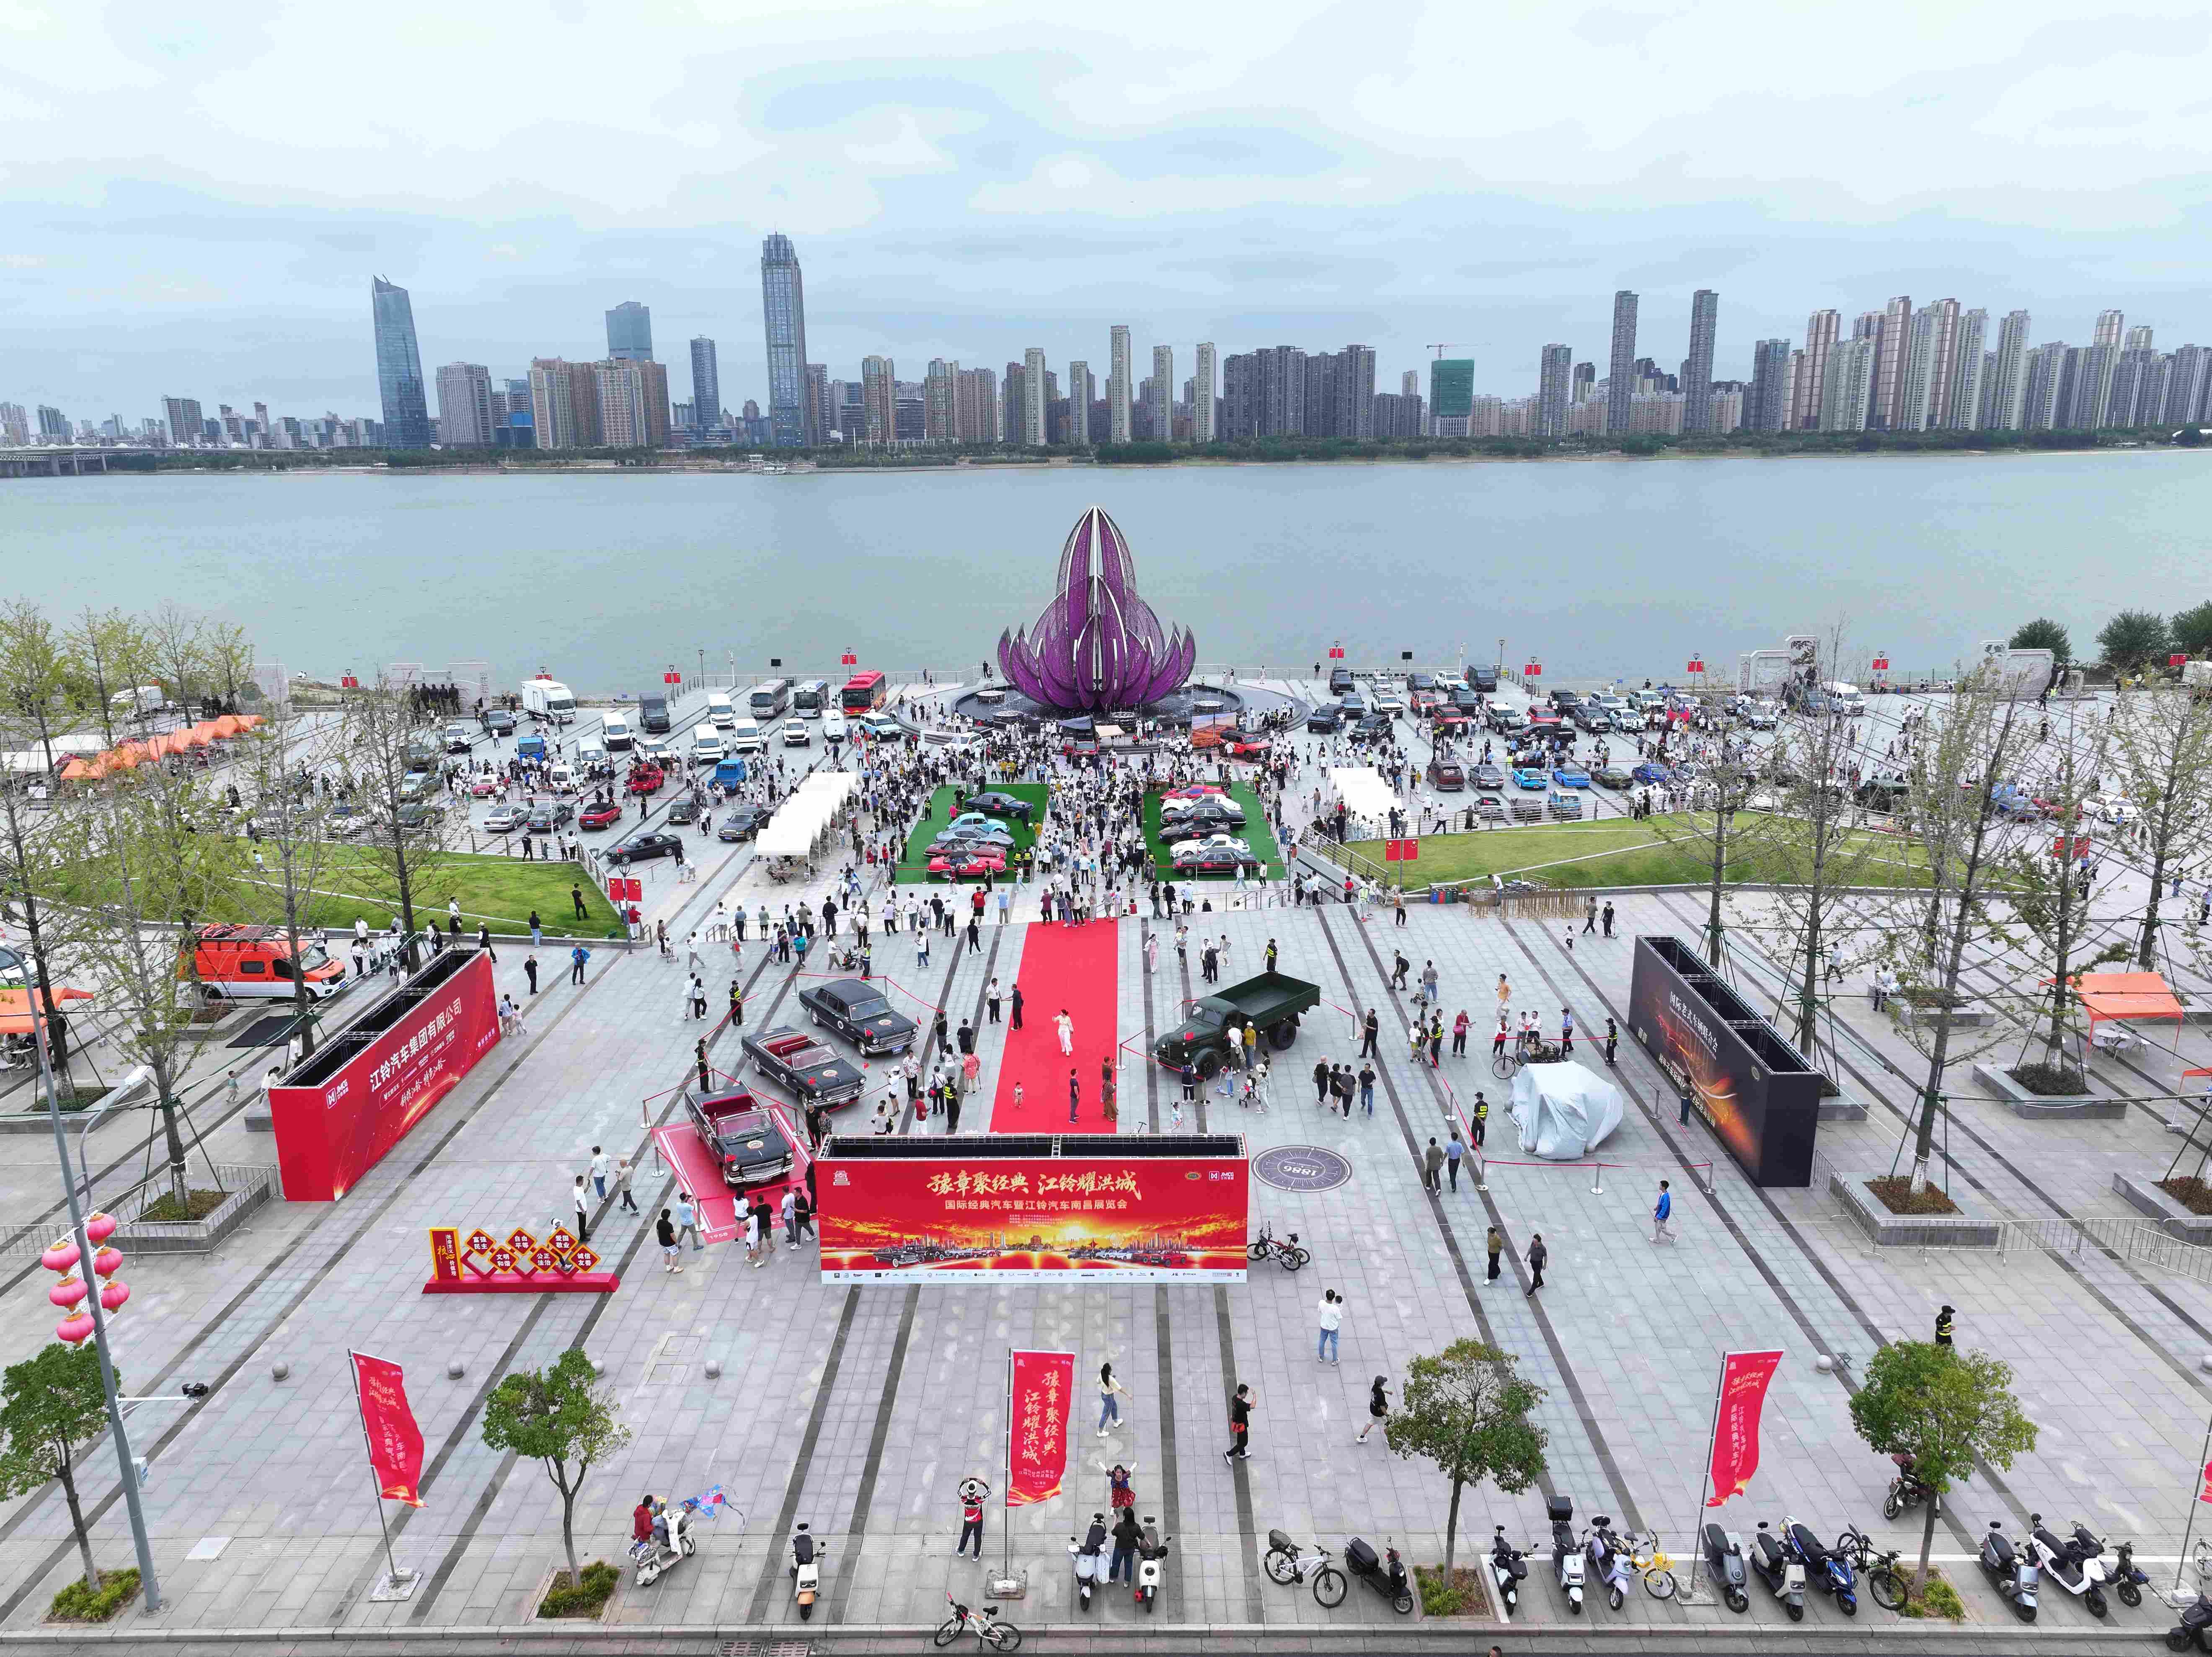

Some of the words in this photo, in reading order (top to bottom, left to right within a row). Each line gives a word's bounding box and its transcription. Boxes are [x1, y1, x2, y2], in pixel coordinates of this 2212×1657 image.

[1670, 991, 1718, 1052] 国际老式车辆联合会
[370, 997, 461, 1092] 江铃汽车集团有限公司
[337, 1079, 348, 1094] JMCG
[926, 1170, 1030, 1199] 豫章聚经典
[1038, 1170, 1142, 1200] 江铃耀洪城
[1283, 1165, 1317, 1176] 1886
[945, 1199, 1128, 1210] 国际经典汽车暨江铃汽车南昌展览会
[1022, 1389, 1042, 1466] 江铃耀洪城
[1041, 1370, 1061, 1456] 豫章聚经典
